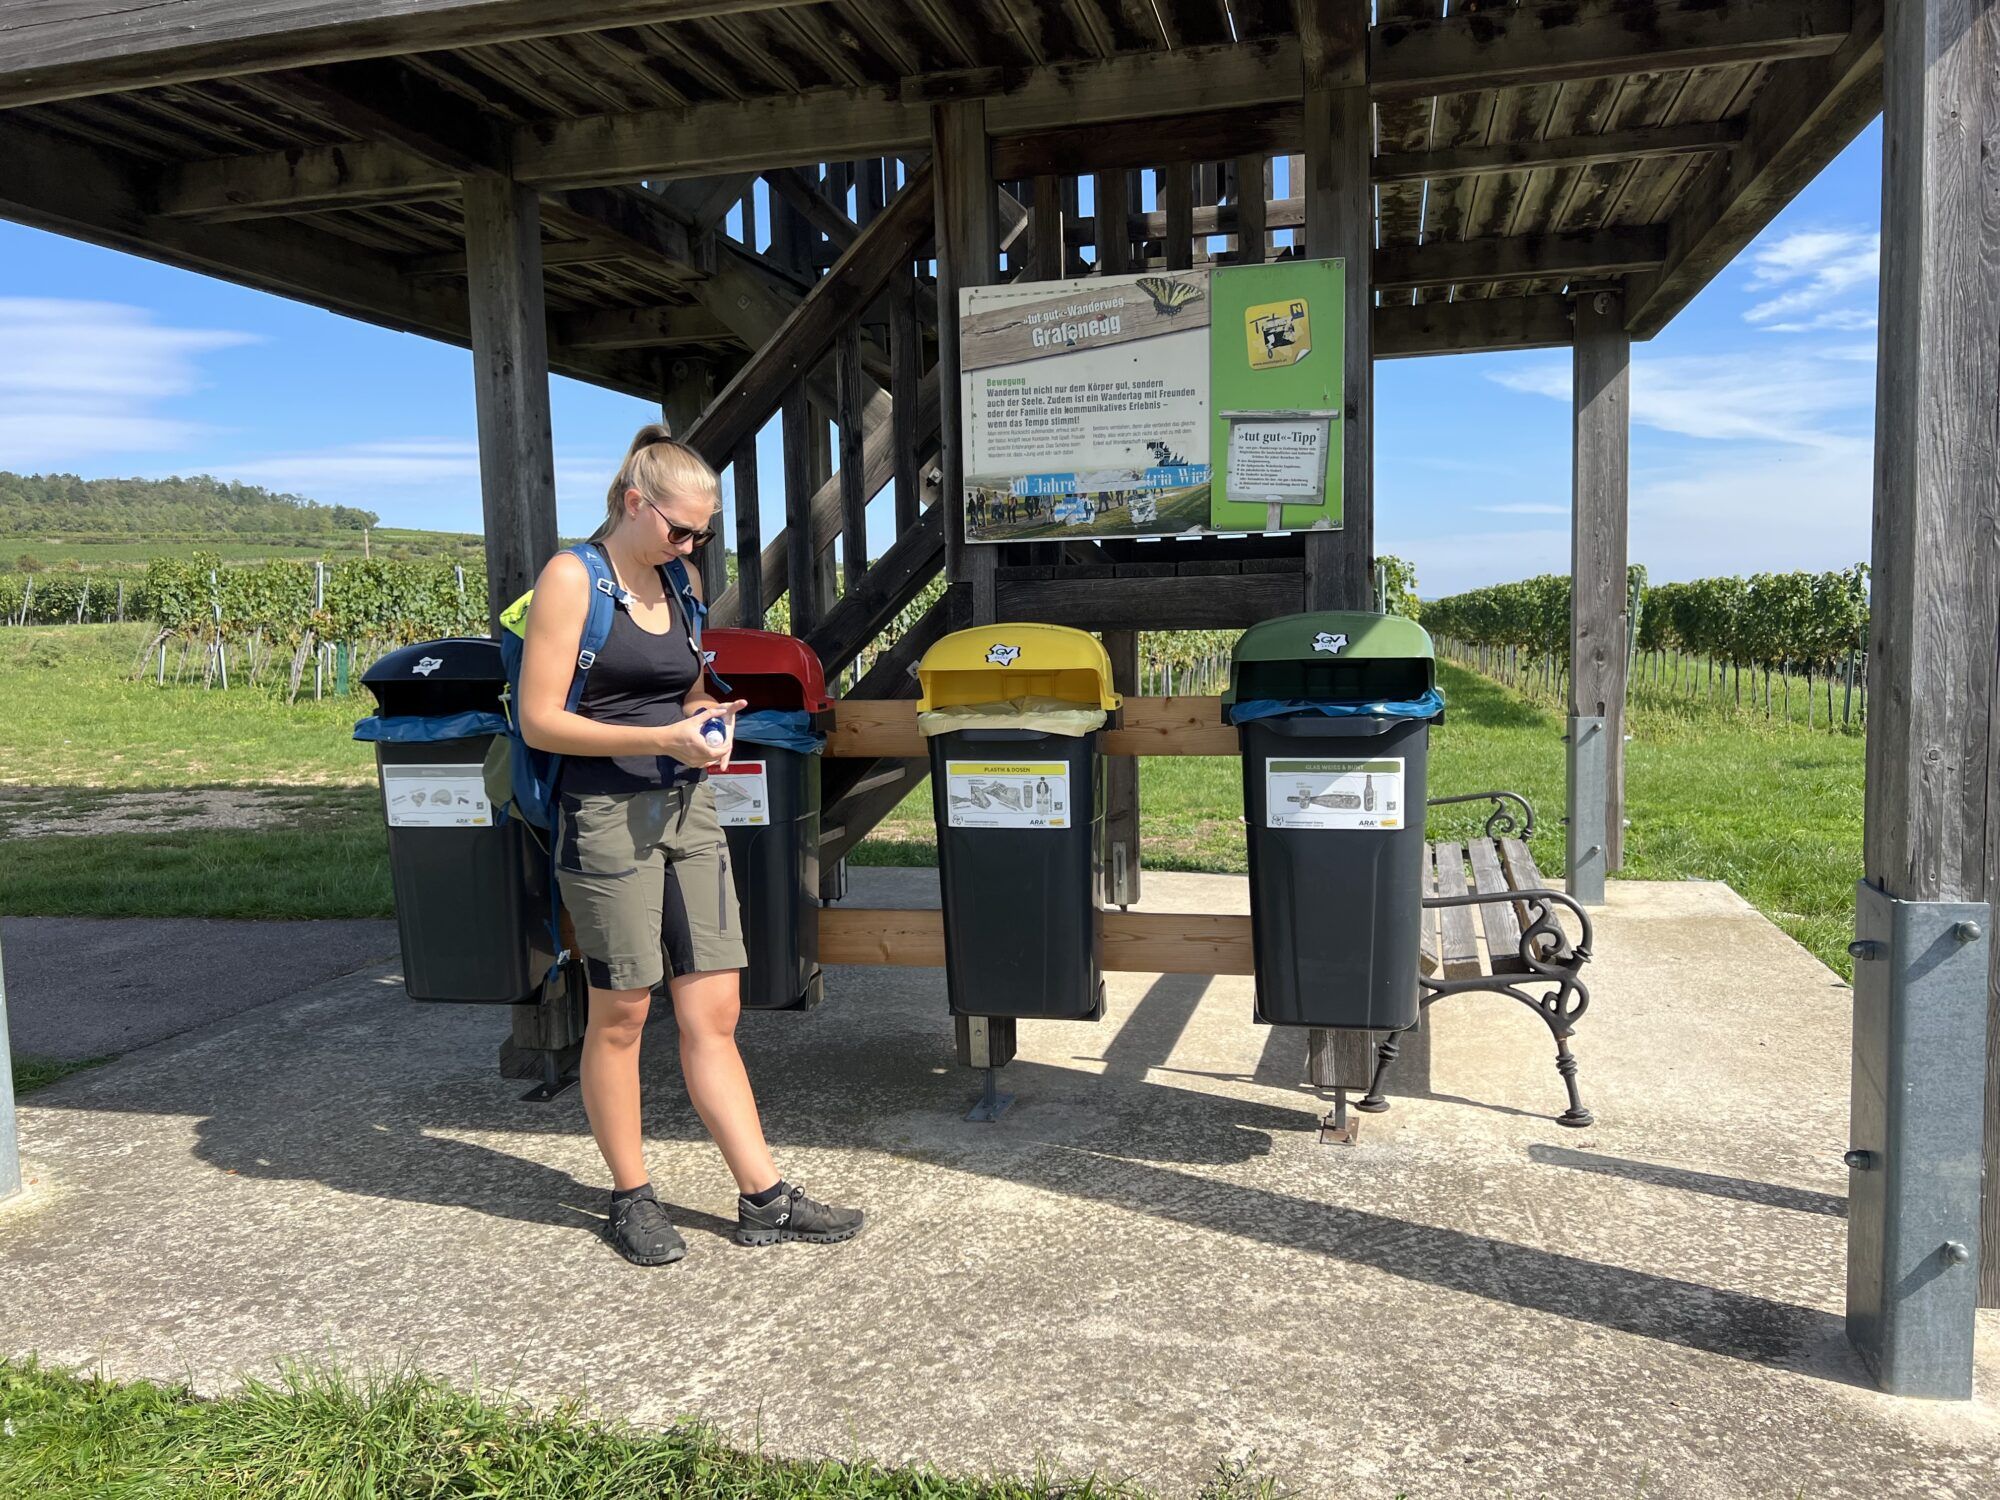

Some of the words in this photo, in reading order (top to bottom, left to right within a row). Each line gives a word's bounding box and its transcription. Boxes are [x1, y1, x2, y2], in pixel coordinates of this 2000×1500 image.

[1032, 315, 1120, 347] Grafenegg
[986, 387, 1020, 397] Wandern
[1021, 387, 1032, 395] tut
[1033, 385, 1053, 395] nicht
[1054, 386, 1067, 394] nur
[1069, 384, 1086, 393] dem
[1087, 382, 1113, 392] Körper
[1115, 381, 1130, 390] gut,
[1132, 379, 1164, 389] sondern
[987, 378, 1026, 387] Bewegung
[987, 398, 1005, 408] auch
[1007, 398, 1020, 407] der
[1021, 397, 1046, 406] Seele.
[1047, 395, 1073, 405] Zudem
[1074, 393, 1085, 403] ist
[1086, 393, 1099, 403] ein
[1101, 391, 1142, 402] Wandertag
[1144, 390, 1158, 399] mit
[1159, 388, 1196, 399] Freunden
[987, 409, 1004, 418] oder
[1006, 408, 1018, 417] der
[1020, 407, 1048, 417] Familie
[1050, 406, 1062, 415] ein
[1064, 402, 1127, 414] kommunikatives
[1129, 400, 1161, 411] Erlebnis
[987, 419, 1008, 429] wenn
[1009, 419, 1023, 428] das
[1024, 417, 1049, 427] Tempo
[1051, 416, 1080, 426] stimmt!
[1034, 477, 1076, 494] Jahre
